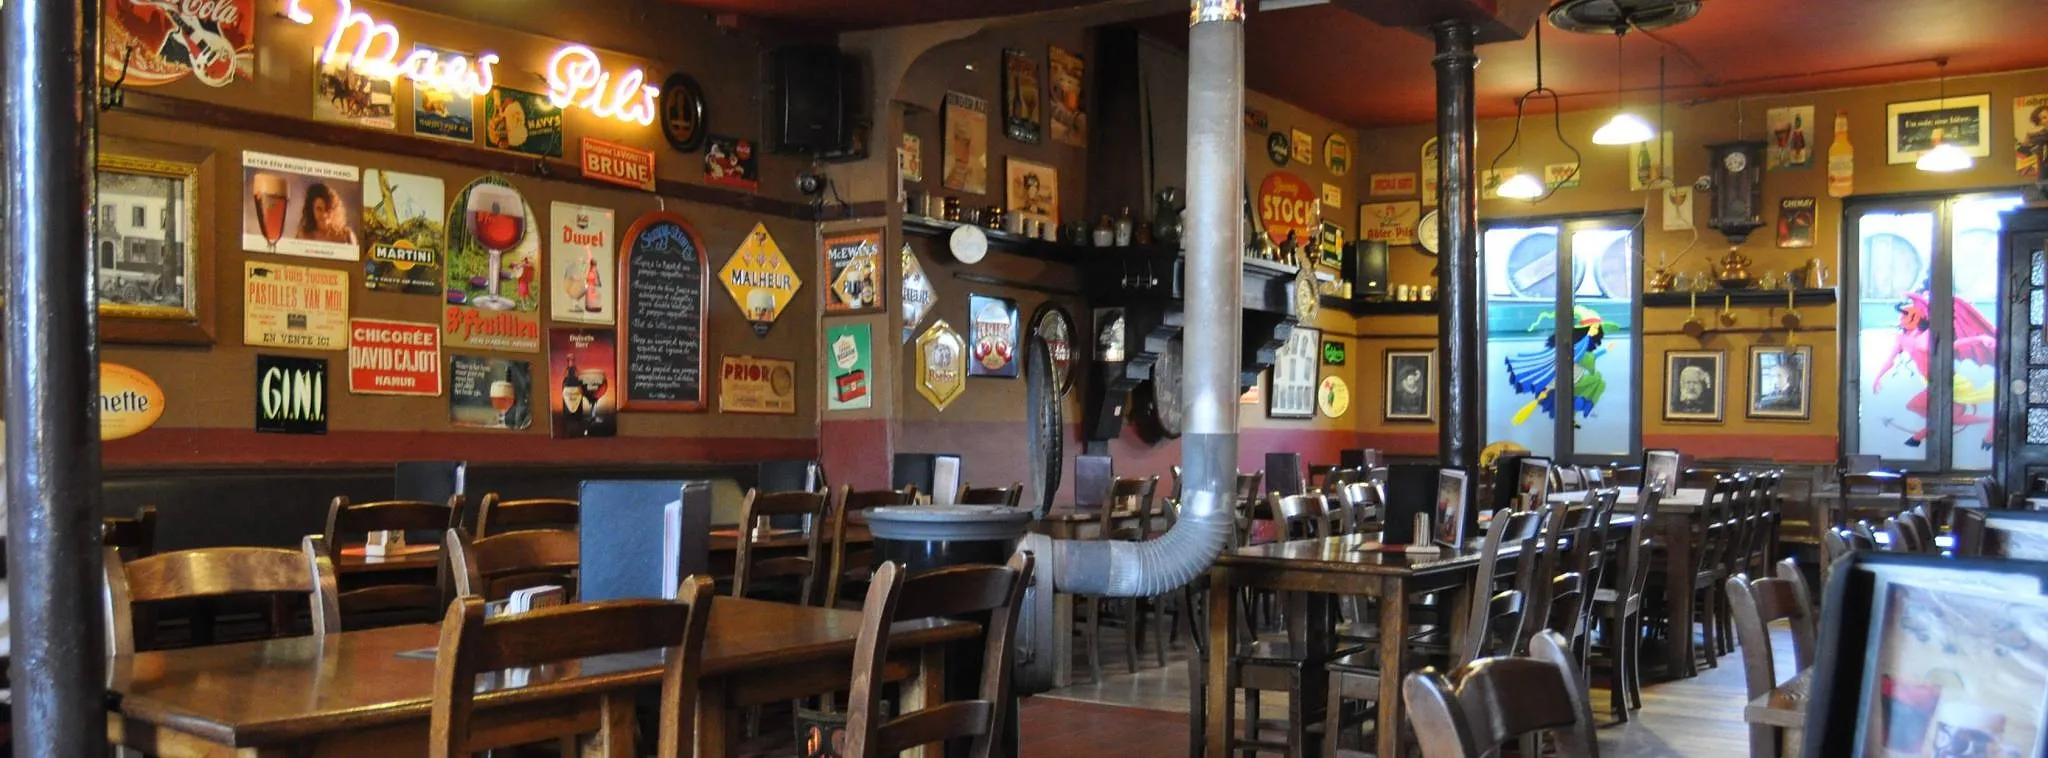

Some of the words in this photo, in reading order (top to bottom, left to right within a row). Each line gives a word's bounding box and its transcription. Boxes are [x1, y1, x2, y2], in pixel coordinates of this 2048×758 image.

[548, 44, 660, 127] Pils
[588, 153, 650, 184] BRUNE
[562, 225, 604, 248] Duvel
[376, 247, 431, 262] MARTINI
[731, 269, 793, 290] MALHEUR
[248, 281, 298, 308] PASTILLES
[263, 332, 277, 343] EN
[280, 334, 314, 345] VENTE
[354, 328, 433, 346] CHICORÉE
[351, 346, 393, 370] DAVID
[394, 348, 436, 373] CAJOT
[375, 375, 416, 387] NAMUR
[724, 363, 771, 383] PRIOR
